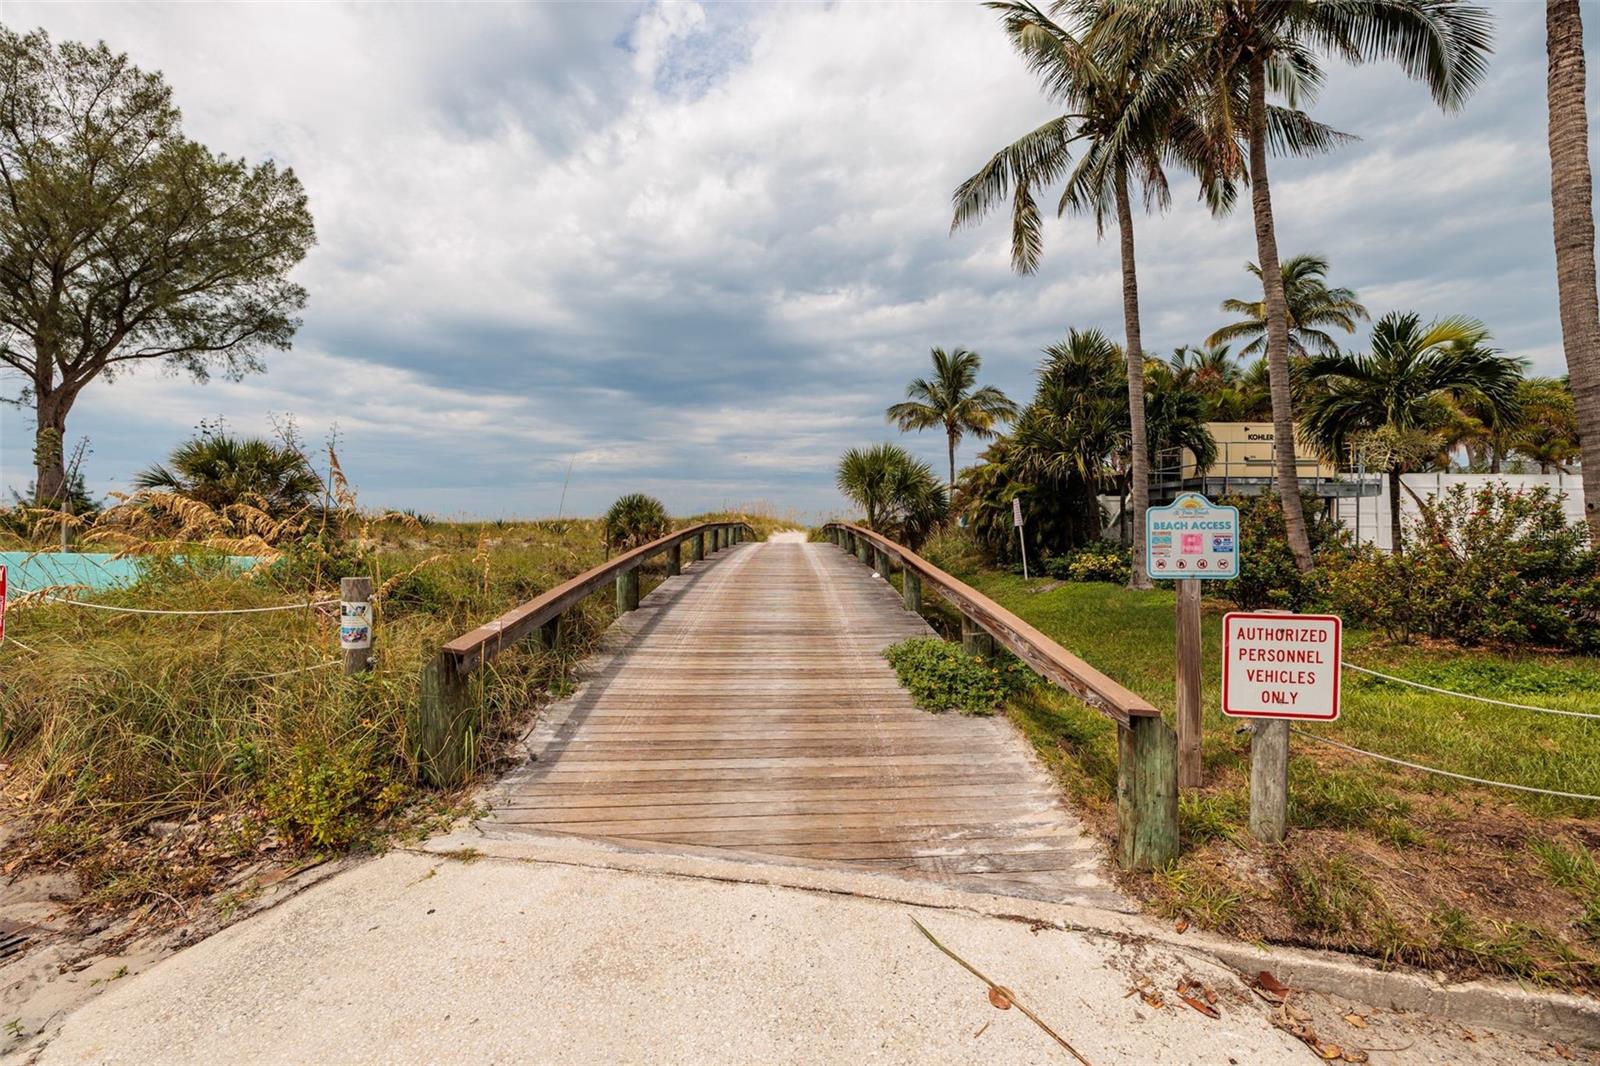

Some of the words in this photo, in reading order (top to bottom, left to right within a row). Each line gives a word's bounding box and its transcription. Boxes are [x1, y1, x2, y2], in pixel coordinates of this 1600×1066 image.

[1248, 433, 1274, 441] KOHLER
[1153, 521, 1188, 530] BEACH
[1191, 521, 1232, 530] ACCESS
[1237, 627, 1328, 643] AUTHORIZED
[1239, 648, 1324, 664] PERSONNEL
[1247, 669, 1316, 685] VEHICLES
[1261, 690, 1298, 705] ONLY
